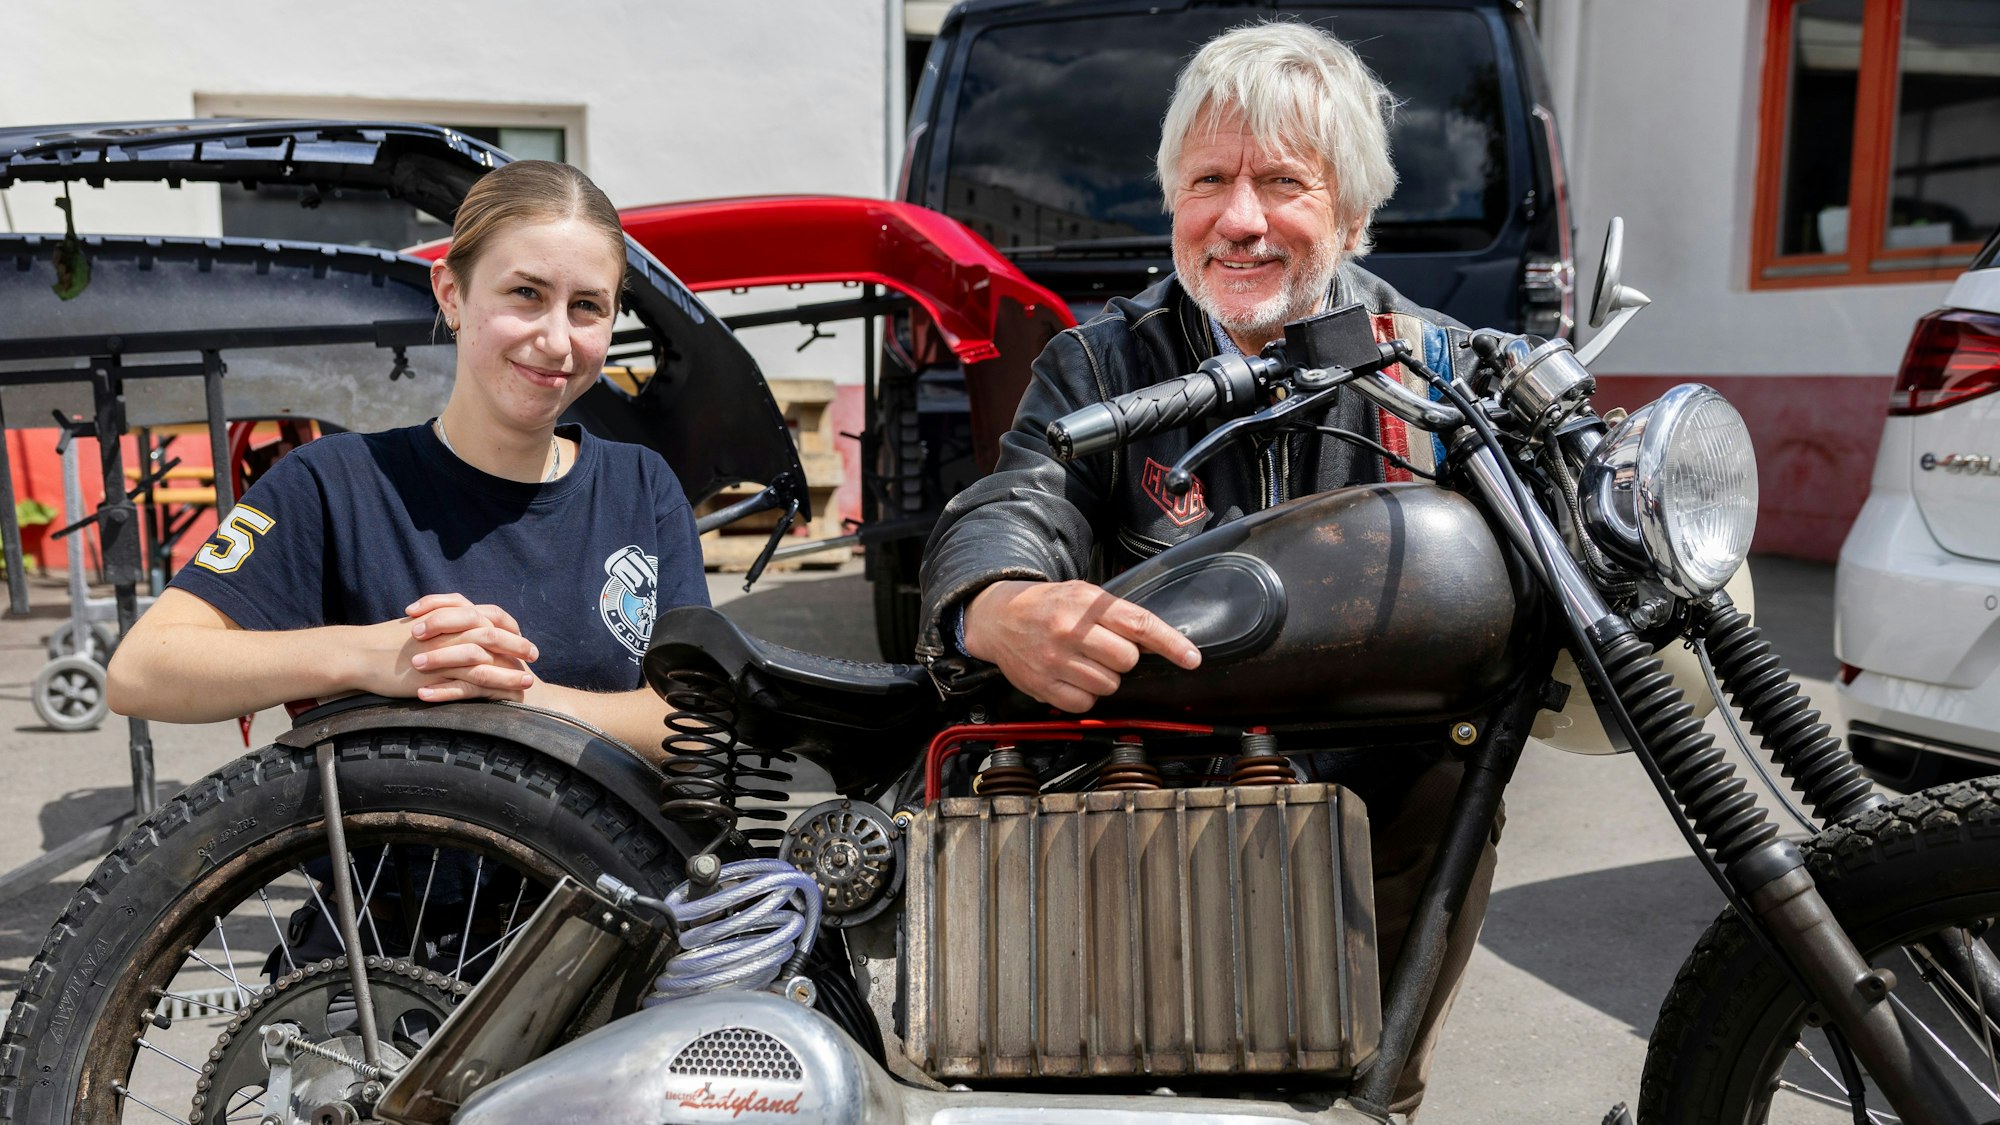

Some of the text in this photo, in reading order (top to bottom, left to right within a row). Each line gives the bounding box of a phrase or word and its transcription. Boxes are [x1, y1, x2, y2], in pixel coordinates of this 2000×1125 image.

[1919, 452, 2000, 477] e-GOL
[194, 503, 277, 574] 5
[665, 1083, 804, 1119] Electric Ladyland
